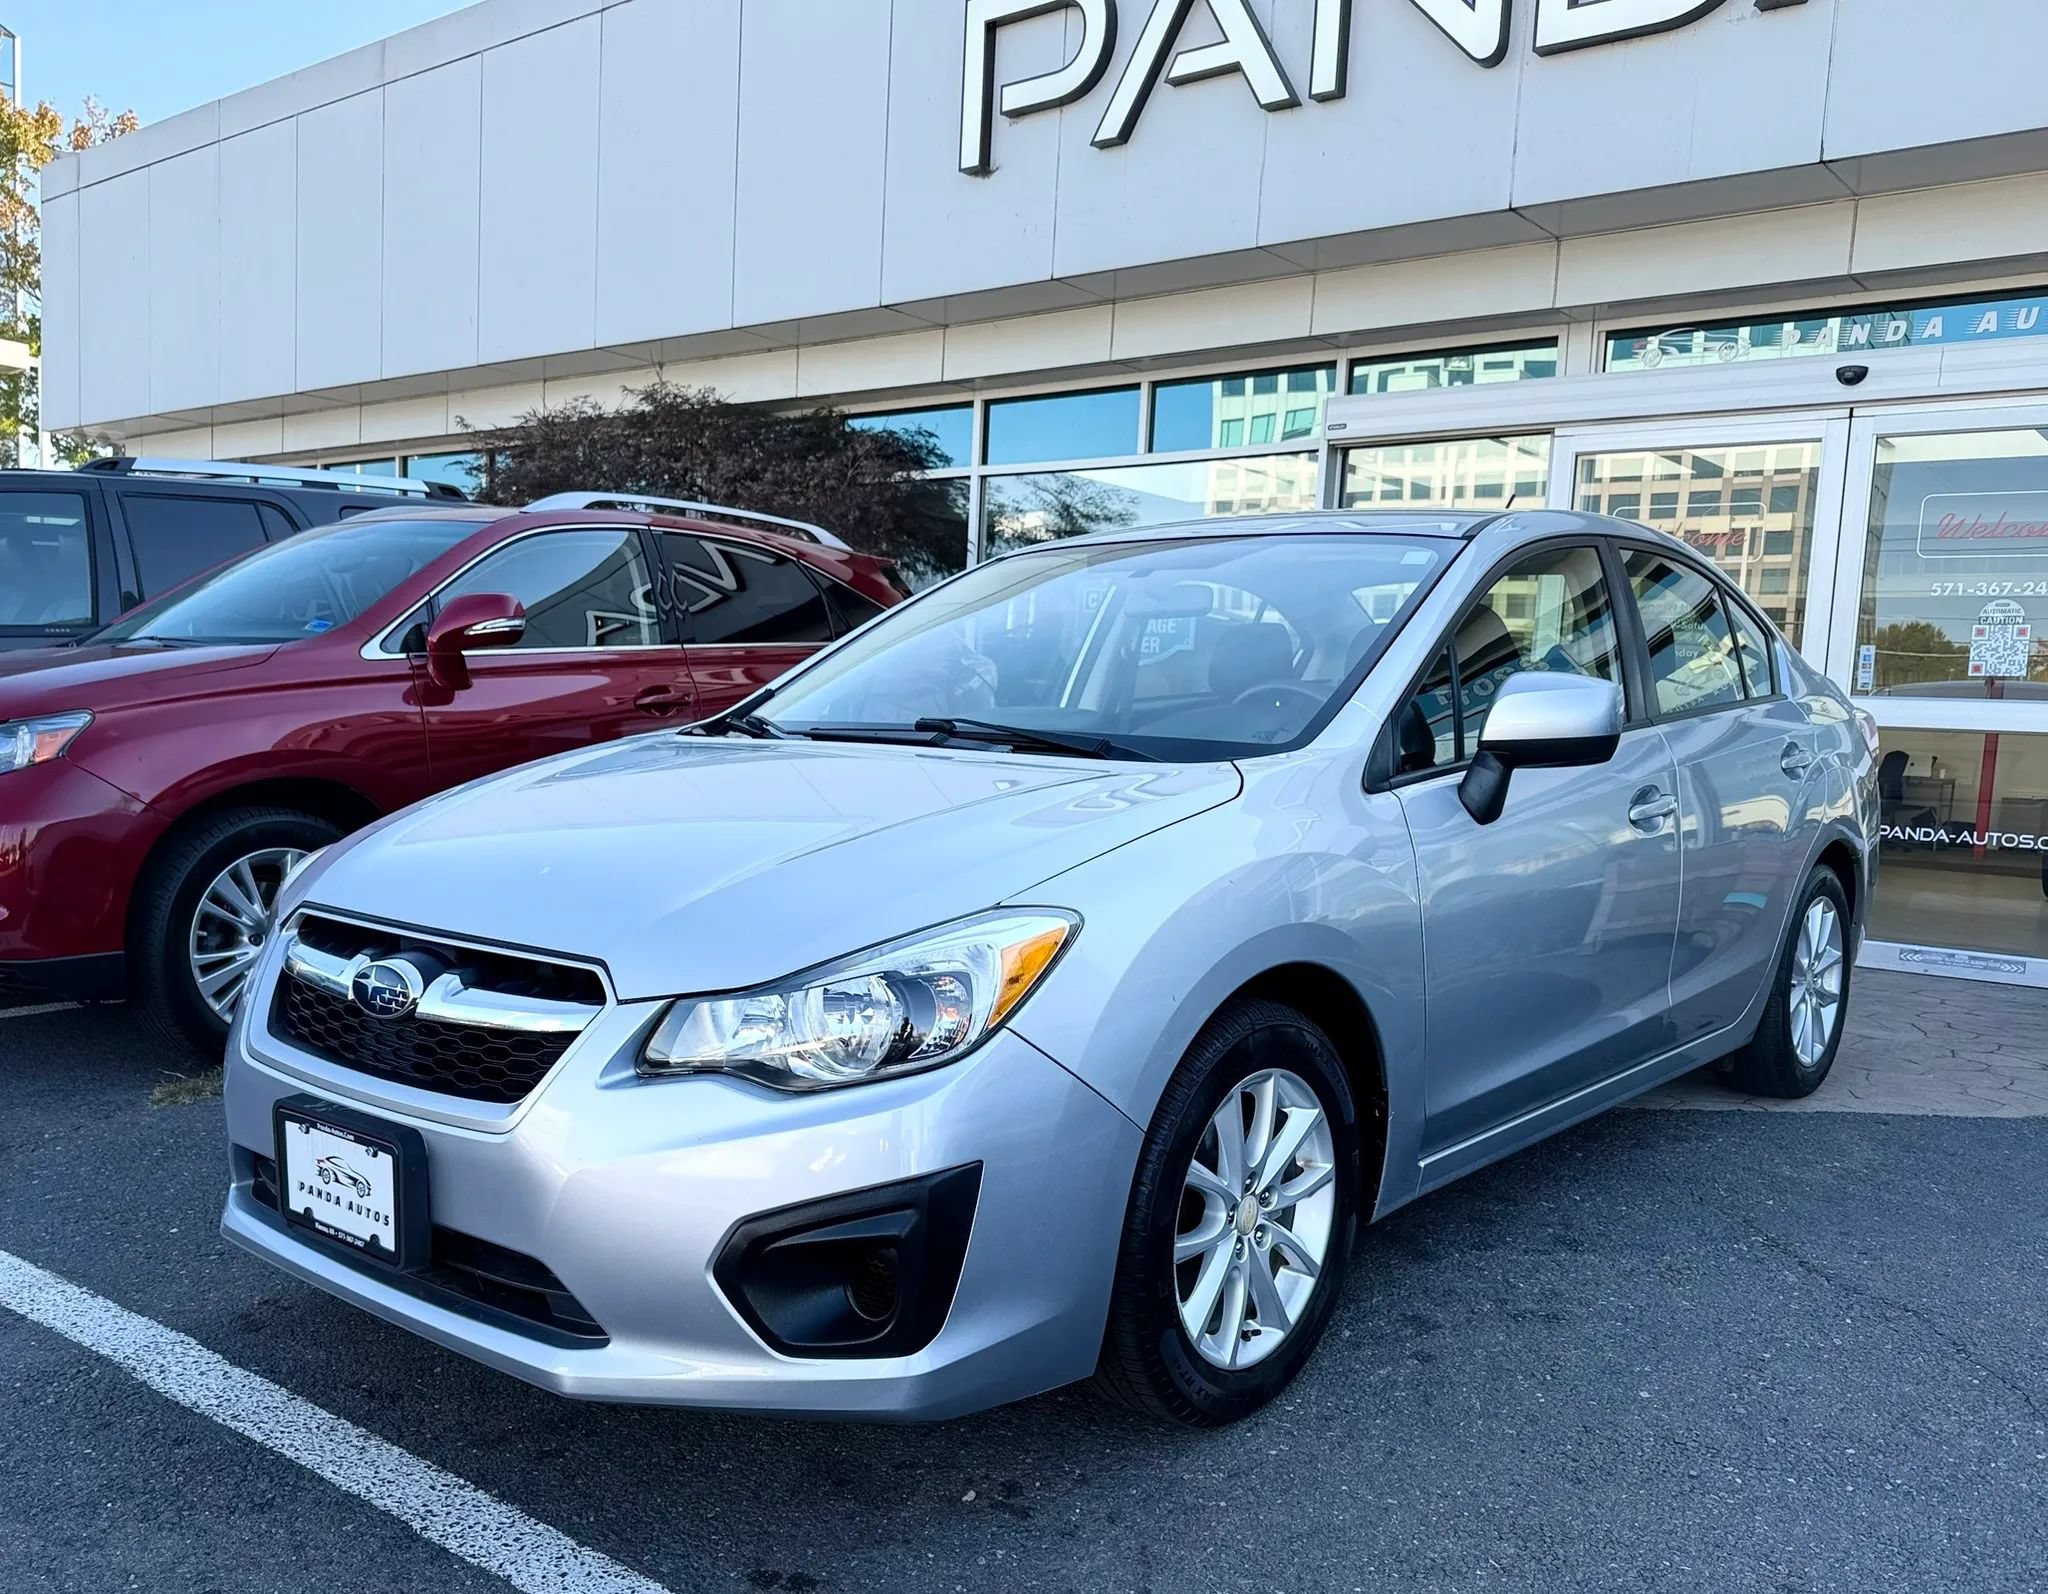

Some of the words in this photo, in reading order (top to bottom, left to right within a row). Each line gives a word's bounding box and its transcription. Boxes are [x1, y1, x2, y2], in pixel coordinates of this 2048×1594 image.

[1775, 315, 1943, 351] PANDA
[1980, 616, 2024, 625] CAUTION
[1982, 607, 2022, 615] AUTOMATIC
[297, 1181, 342, 1208] PANDA
[347, 1200, 391, 1227] AUTOS
